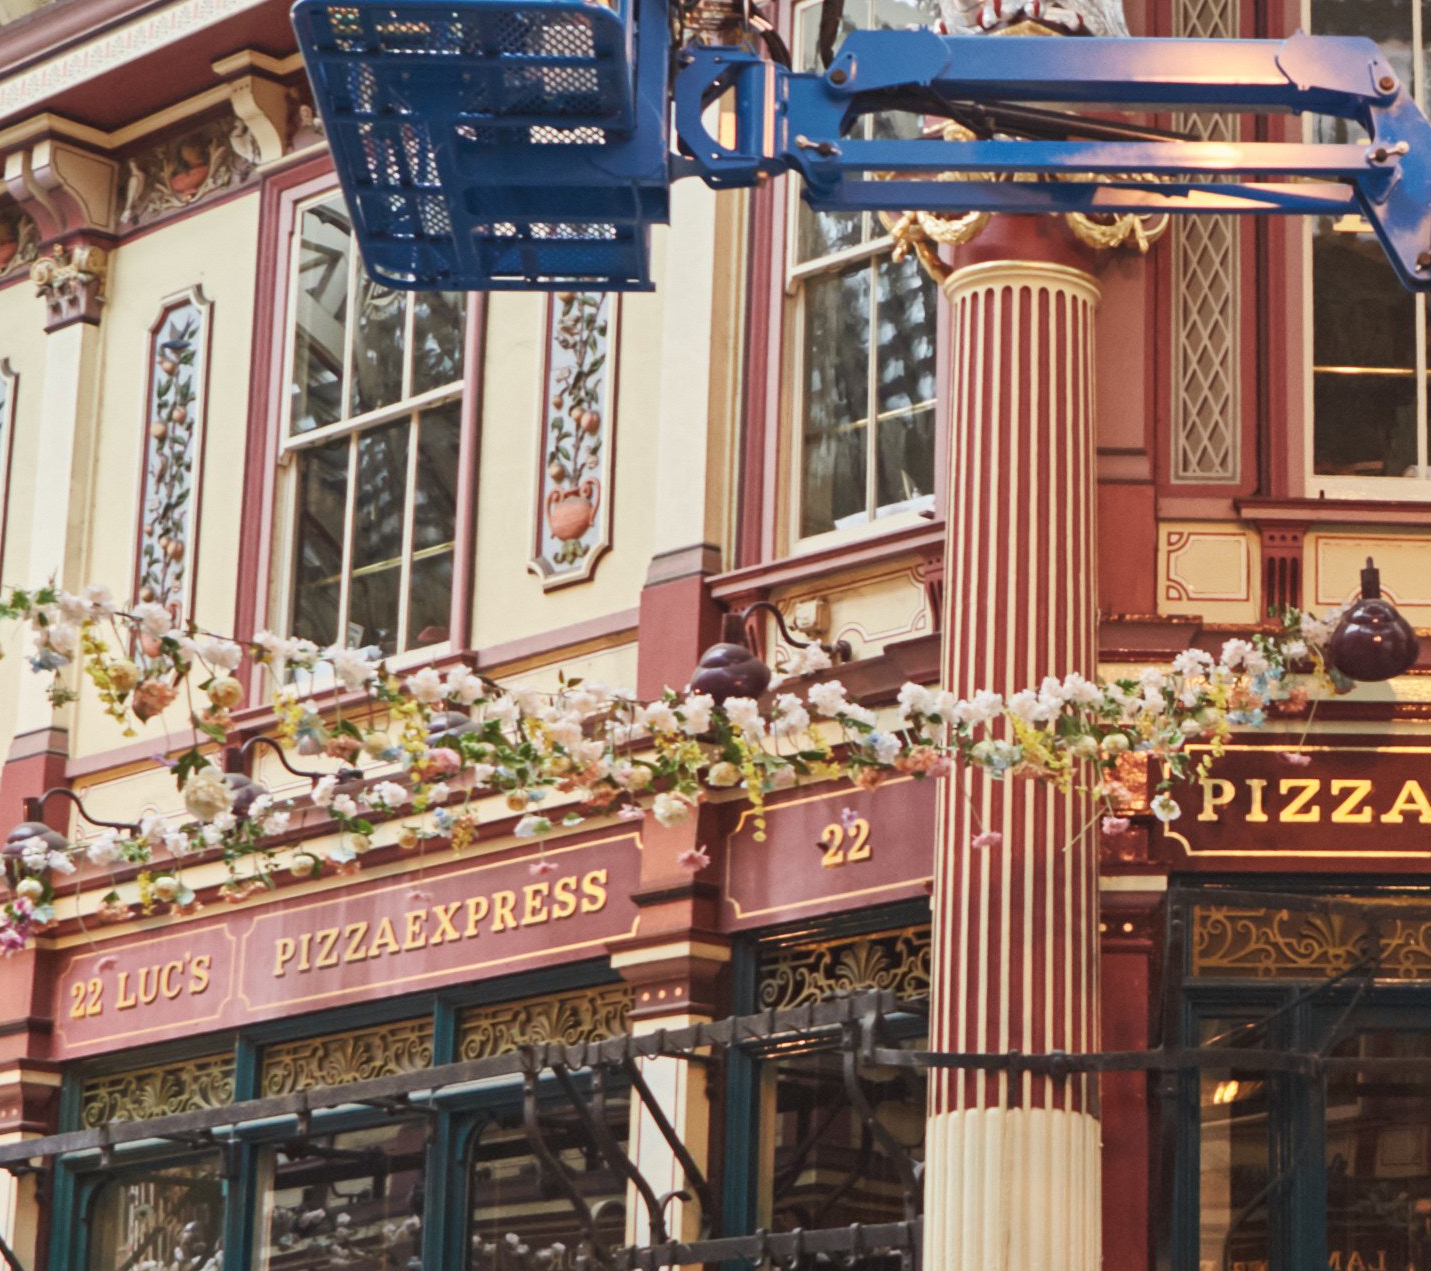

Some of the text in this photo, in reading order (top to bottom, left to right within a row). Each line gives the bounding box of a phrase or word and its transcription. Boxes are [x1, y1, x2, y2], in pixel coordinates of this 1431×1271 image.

[821, 818, 871, 868] 22
[273, 868, 609, 978] PIZZAEXPRESS
[69, 951, 211, 1019] 22 LUC'S
